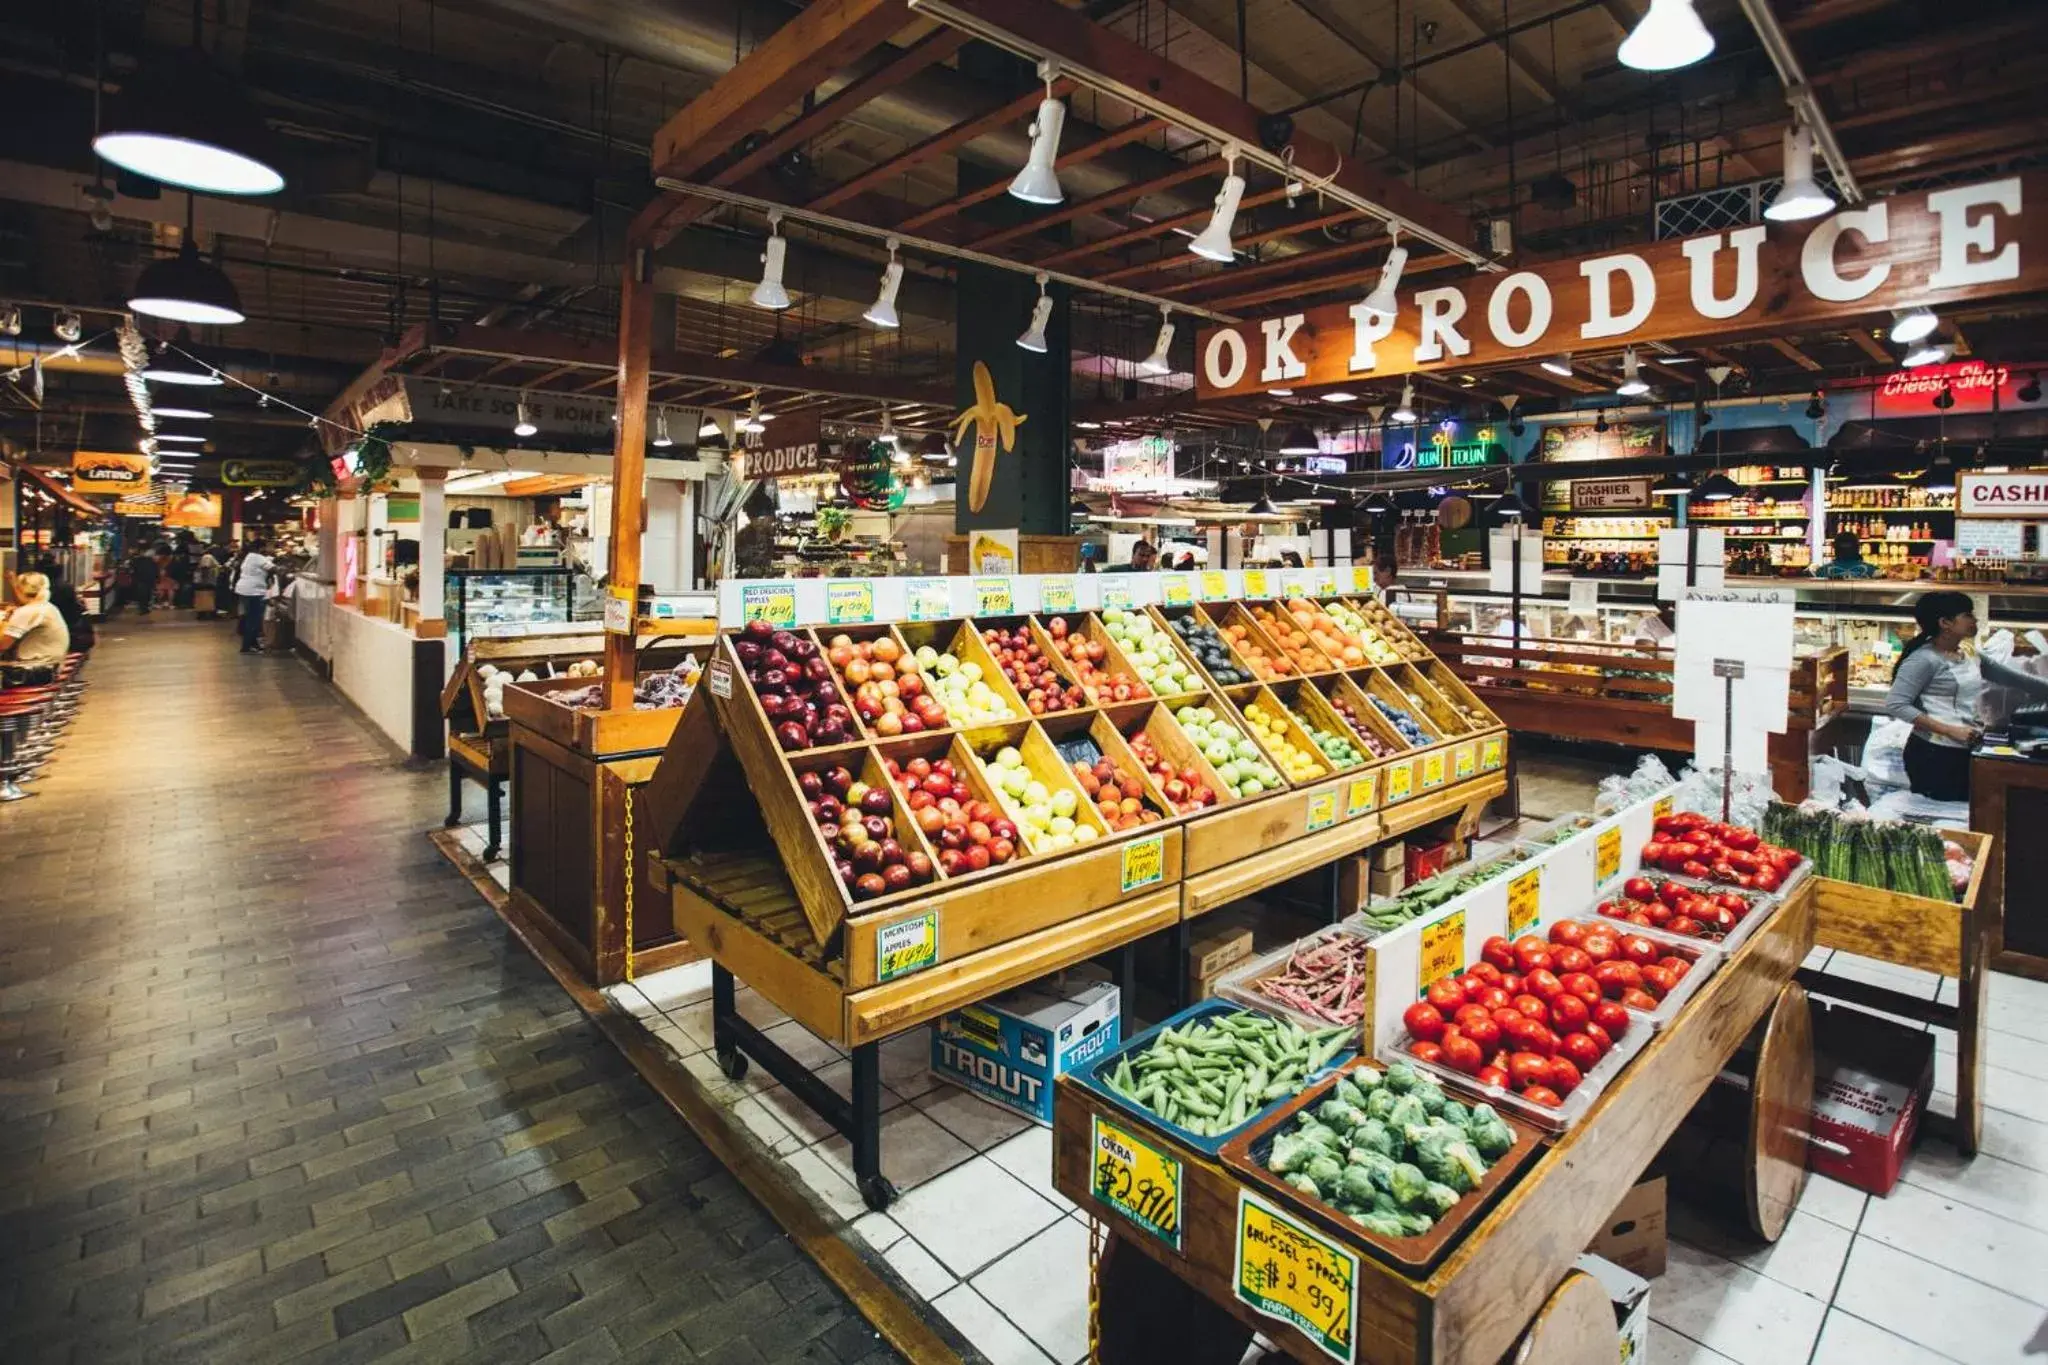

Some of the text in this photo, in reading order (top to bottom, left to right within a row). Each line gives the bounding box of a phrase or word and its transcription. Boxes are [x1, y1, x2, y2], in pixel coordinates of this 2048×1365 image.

[1204, 177, 2023, 389] OK PRODUCE
[1956, 364, 2008, 390] Shop
[490, 401, 543, 418] SOE
[744, 443, 818, 475] PRODUCE
[1577, 484, 1630, 496] CASHIER
[1579, 496, 1606, 507] LINE
[1068, 1024, 1113, 1065] TROUT
[940, 1039, 1043, 1102] TROUT
[1101, 1137, 1132, 1163] OKRA
[1262, 1299, 1326, 1344] FARM FRESH
